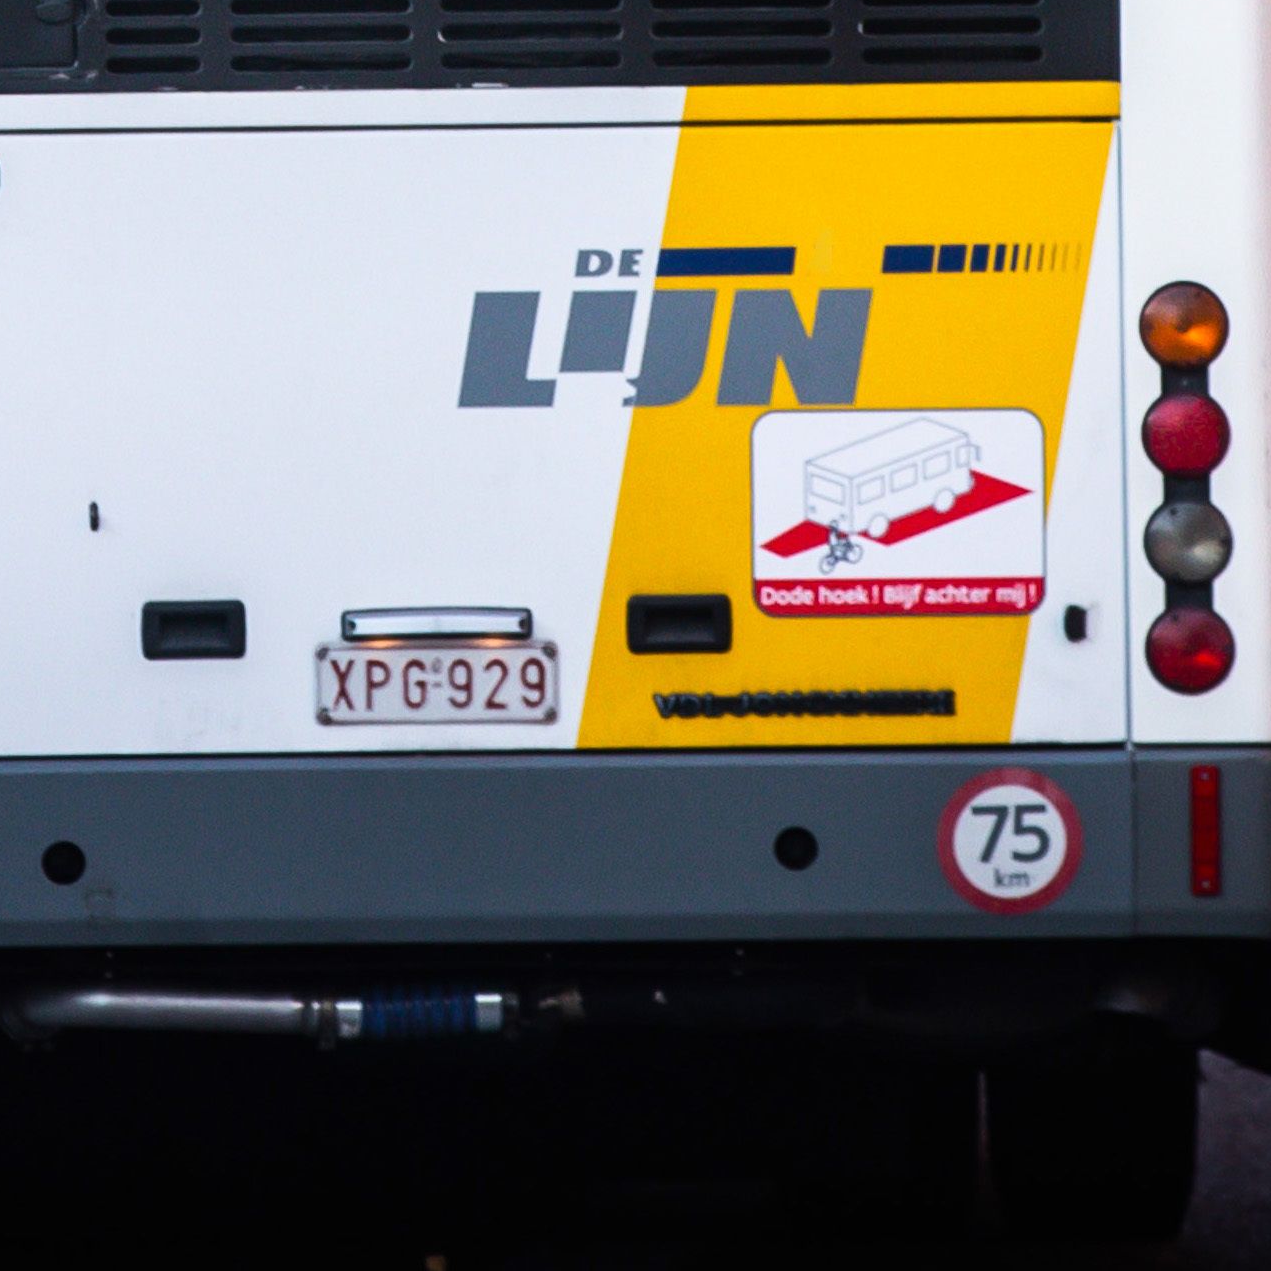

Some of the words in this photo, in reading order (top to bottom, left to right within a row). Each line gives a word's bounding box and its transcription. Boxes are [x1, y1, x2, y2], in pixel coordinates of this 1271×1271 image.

[574, 248, 644, 278] DE
[458, 287, 874, 408] LIJN
[760, 585, 814, 606] Dode
[924, 584, 991, 604] achter
[971, 804, 1051, 864] 75
[994, 868, 1031, 887] km
